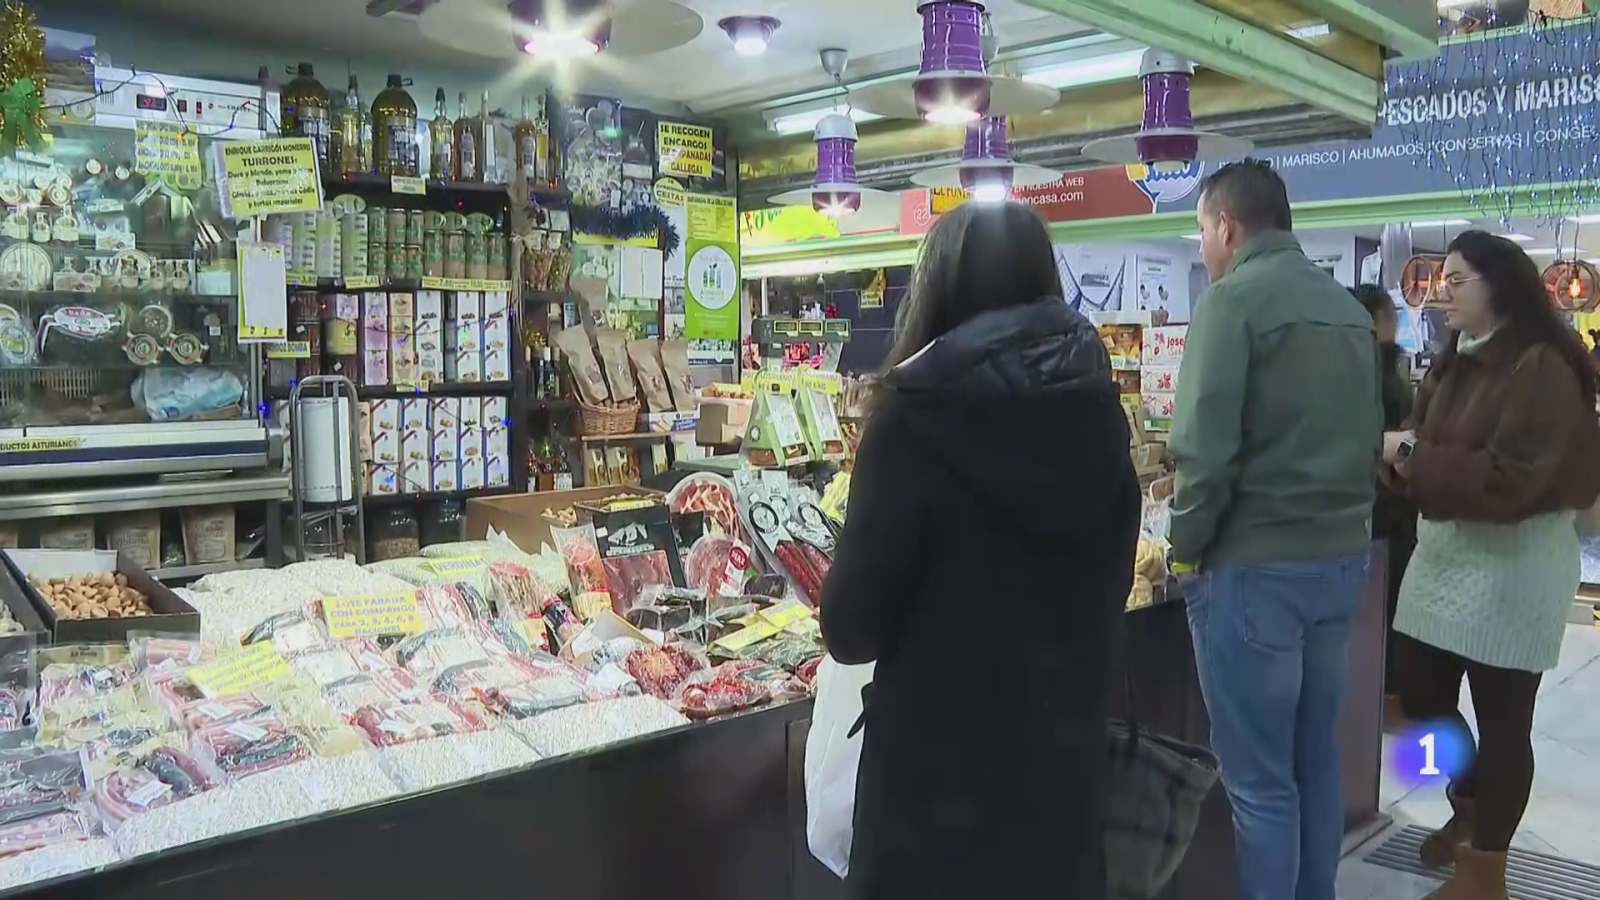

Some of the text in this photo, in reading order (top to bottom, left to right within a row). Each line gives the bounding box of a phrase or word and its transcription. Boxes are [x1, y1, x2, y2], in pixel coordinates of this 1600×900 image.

[1492, 86, 1506, 114] Y
[660, 125, 710, 139] SE RECOGEN
[663, 137, 707, 150] ENCARGOS
[1283, 151, 1339, 168] MARISCO
[671, 162, 703, 175] GALLEGAS
[1065, 177, 1084, 187] WEB
[916, 208, 928, 220] 22
